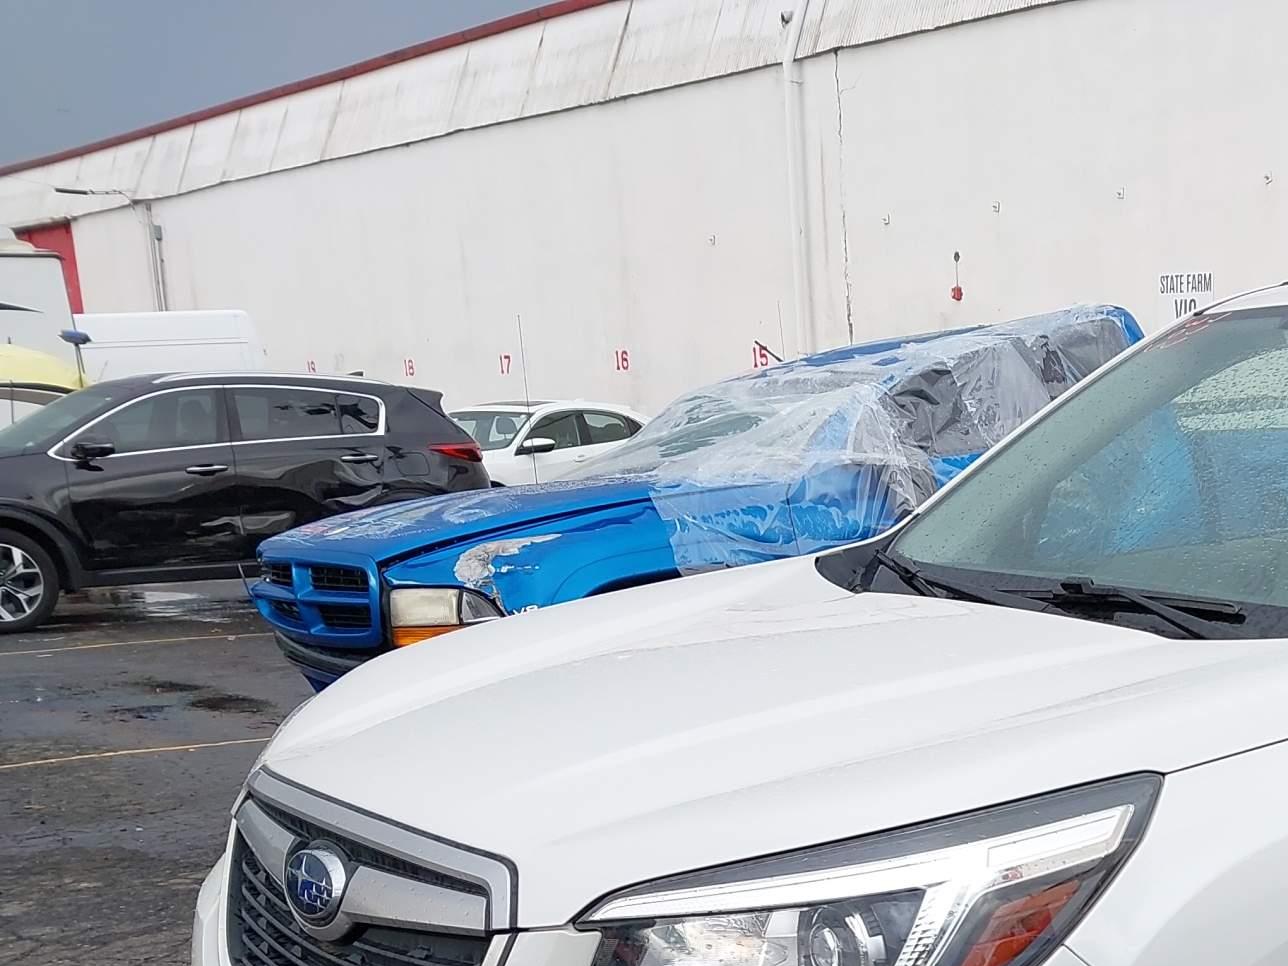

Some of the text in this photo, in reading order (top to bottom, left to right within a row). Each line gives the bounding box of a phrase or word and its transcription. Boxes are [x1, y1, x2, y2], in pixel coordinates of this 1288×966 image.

[1160, 273, 1212, 294] STATE FARM
[499, 354, 511, 375] 17
[615, 350, 629, 371] 16
[753, 345, 768, 368] 15
[403, 359, 415, 377] 18
